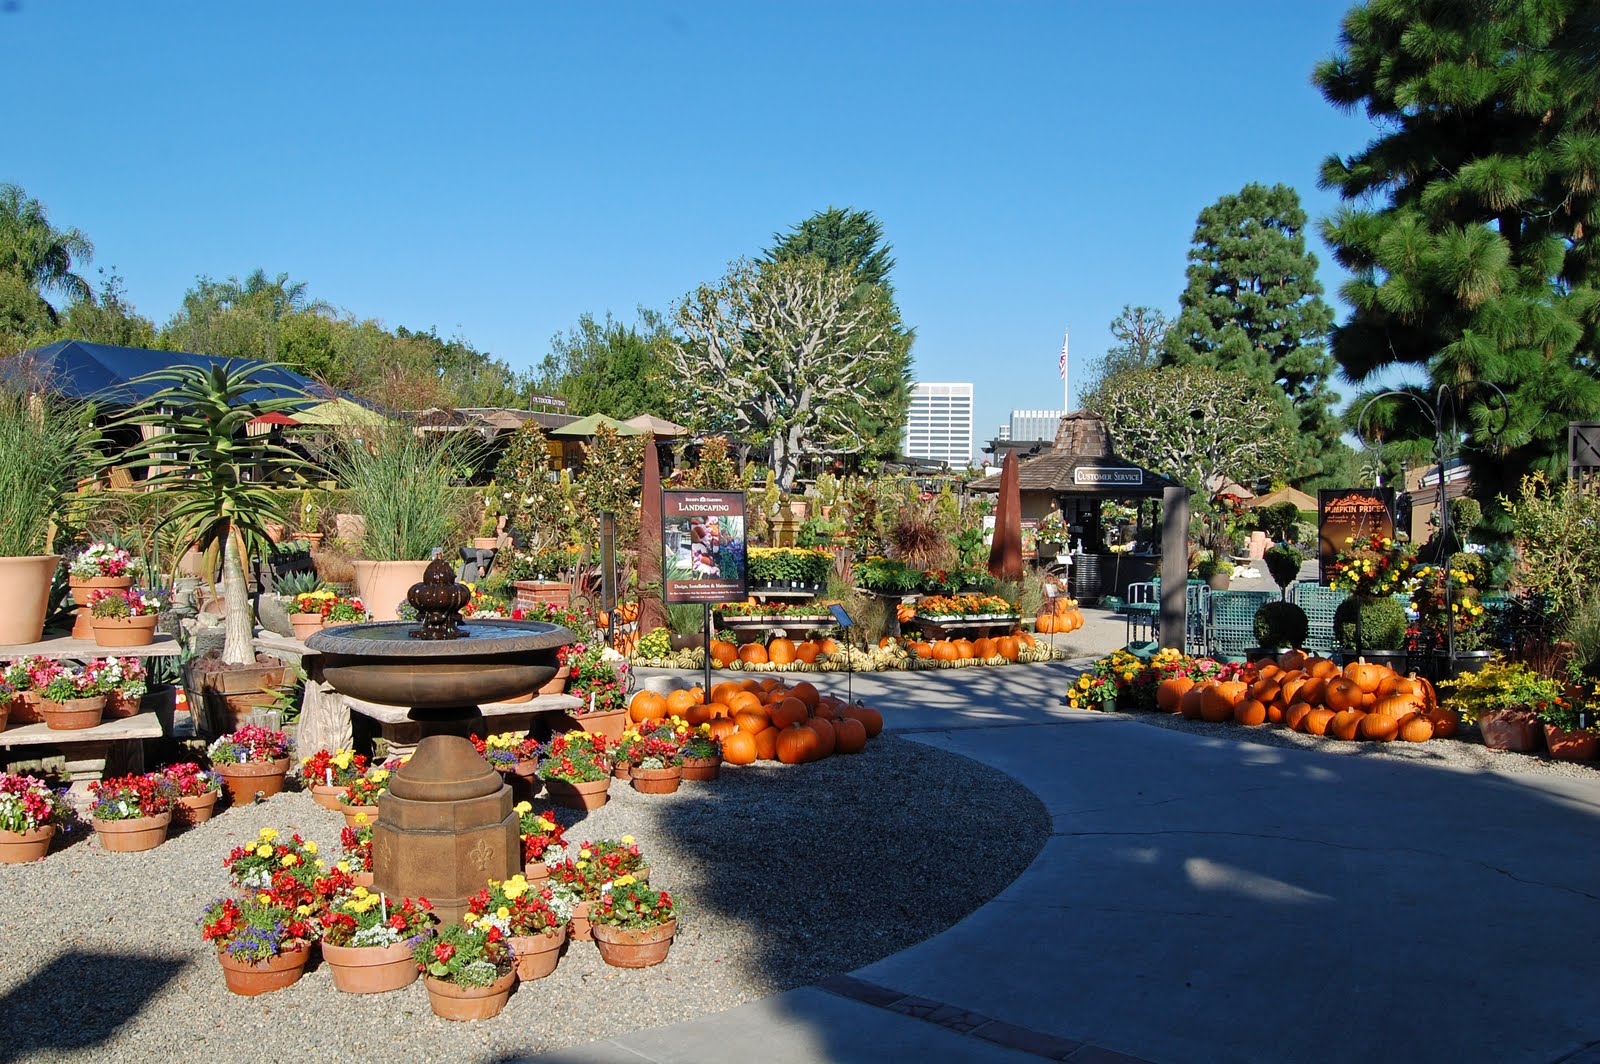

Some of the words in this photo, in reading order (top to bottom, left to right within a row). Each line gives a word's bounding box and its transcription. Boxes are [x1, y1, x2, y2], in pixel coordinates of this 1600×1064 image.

[1077, 471, 1111, 481] CUSTOMER
[1113, 472, 1139, 481] SERVICE
[678, 503, 729, 511] LANDSCAPING
[1359, 505, 1386, 513] PRICES
